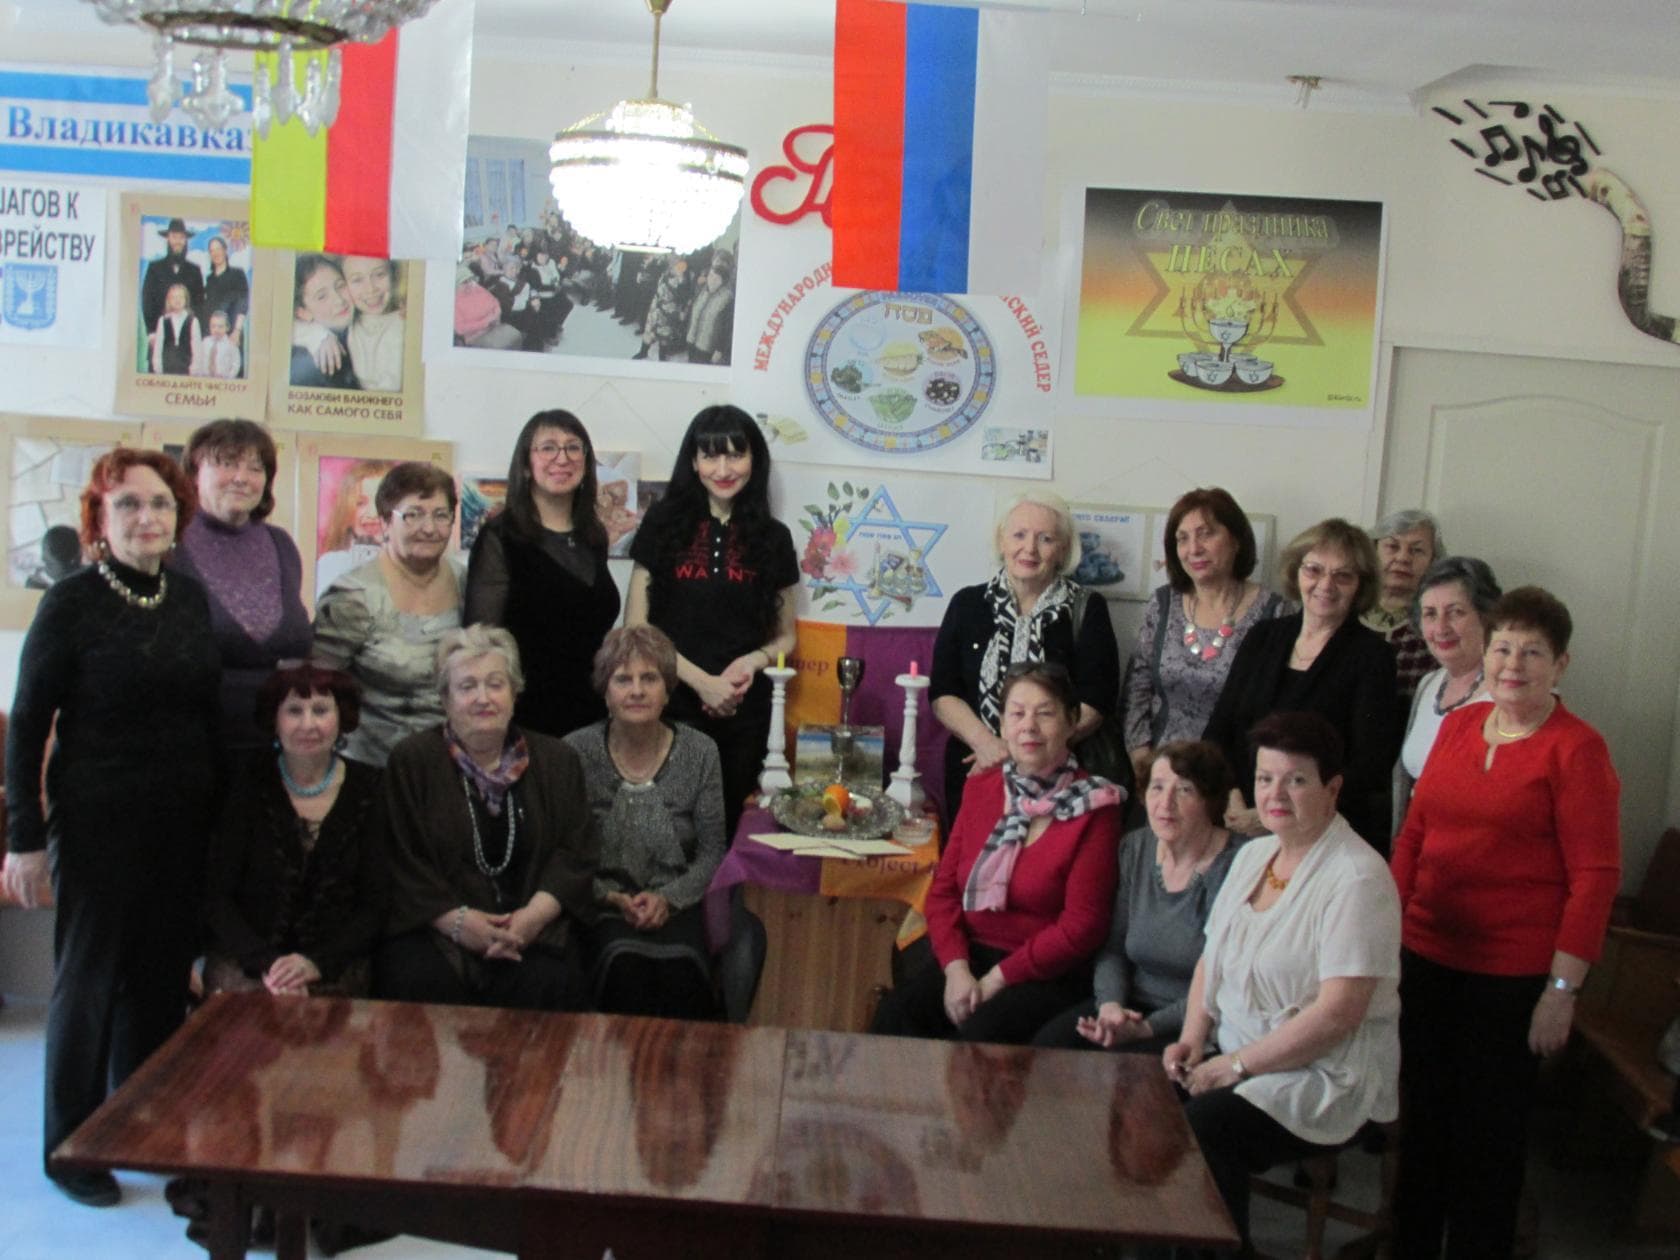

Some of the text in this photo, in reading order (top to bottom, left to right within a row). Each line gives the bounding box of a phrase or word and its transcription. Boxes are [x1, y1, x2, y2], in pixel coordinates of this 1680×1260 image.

[8, 105, 252, 152] Владикавка
[67, 191, 79, 219] К
[1137, 201, 1193, 231] Свет
[0, 225, 95, 262] РЕЙСТВУ
[1167, 244, 1294, 277] ПЕСАХ
[753, 261, 1051, 392] МЕЖДУНАРОДН СКИЙ СЕДЕР
[164, 392, 217, 407] СЕМЬИ
[288, 403, 402, 420] КАК САМОГО СЕБЯ
